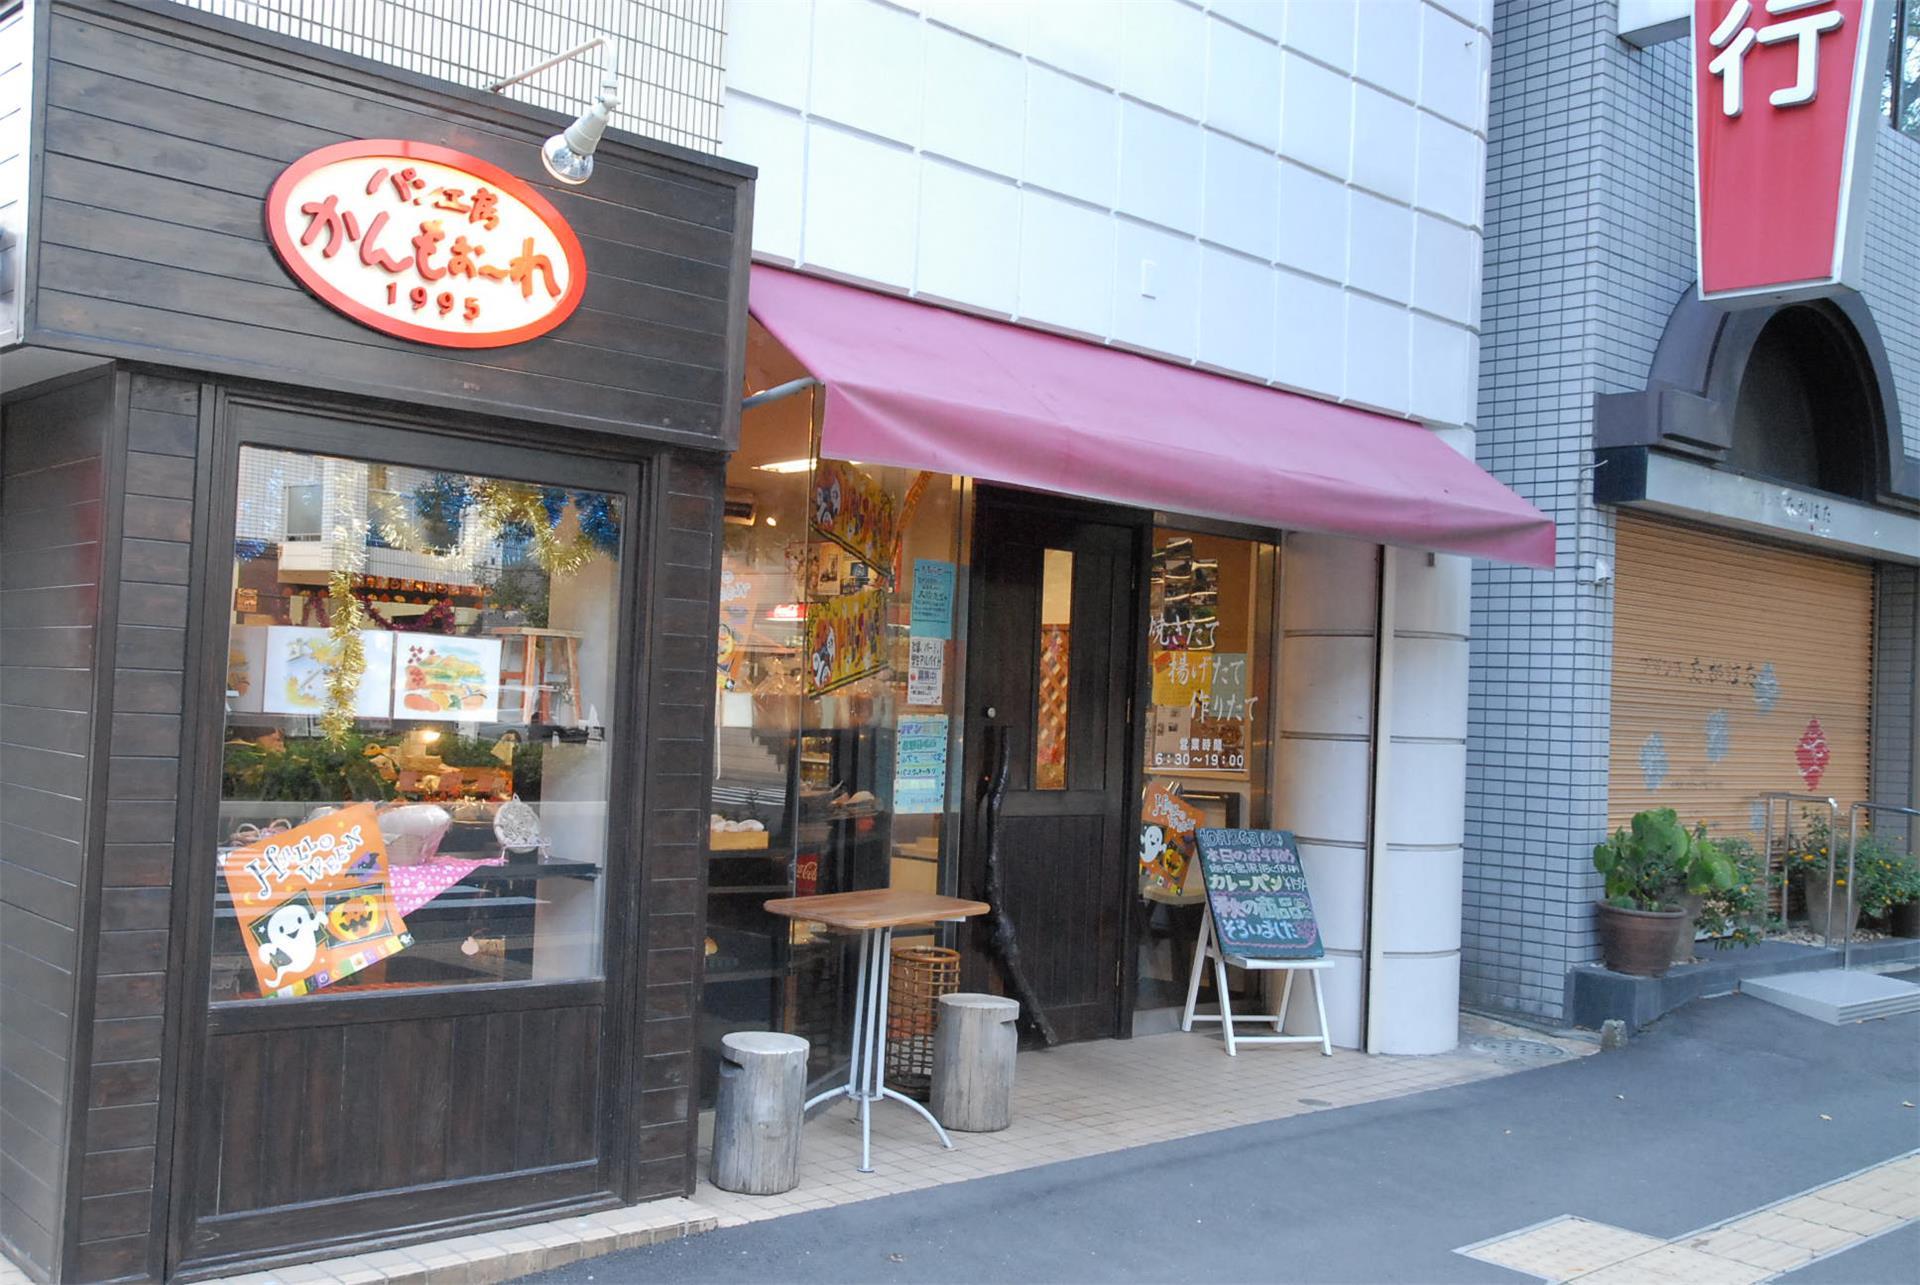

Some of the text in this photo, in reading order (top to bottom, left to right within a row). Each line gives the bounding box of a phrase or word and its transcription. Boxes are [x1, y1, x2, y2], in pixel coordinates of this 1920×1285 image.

[1708, 0, 1845, 117] 行
[366, 167, 500, 230] パン工房
[386, 282, 481, 321] 1995
[1148, 615, 1220, 649] 焼きたて
[1168, 652, 1245, 687] 揚げたて
[1189, 690, 1259, 724] 作りたて
[1179, 737, 1224, 752] 営業時間
[1206, 848, 1295, 863] 本日のおすすめ
[1208, 874, 1283, 892] カレーパン
[1223, 919, 1298, 939] そろいました
